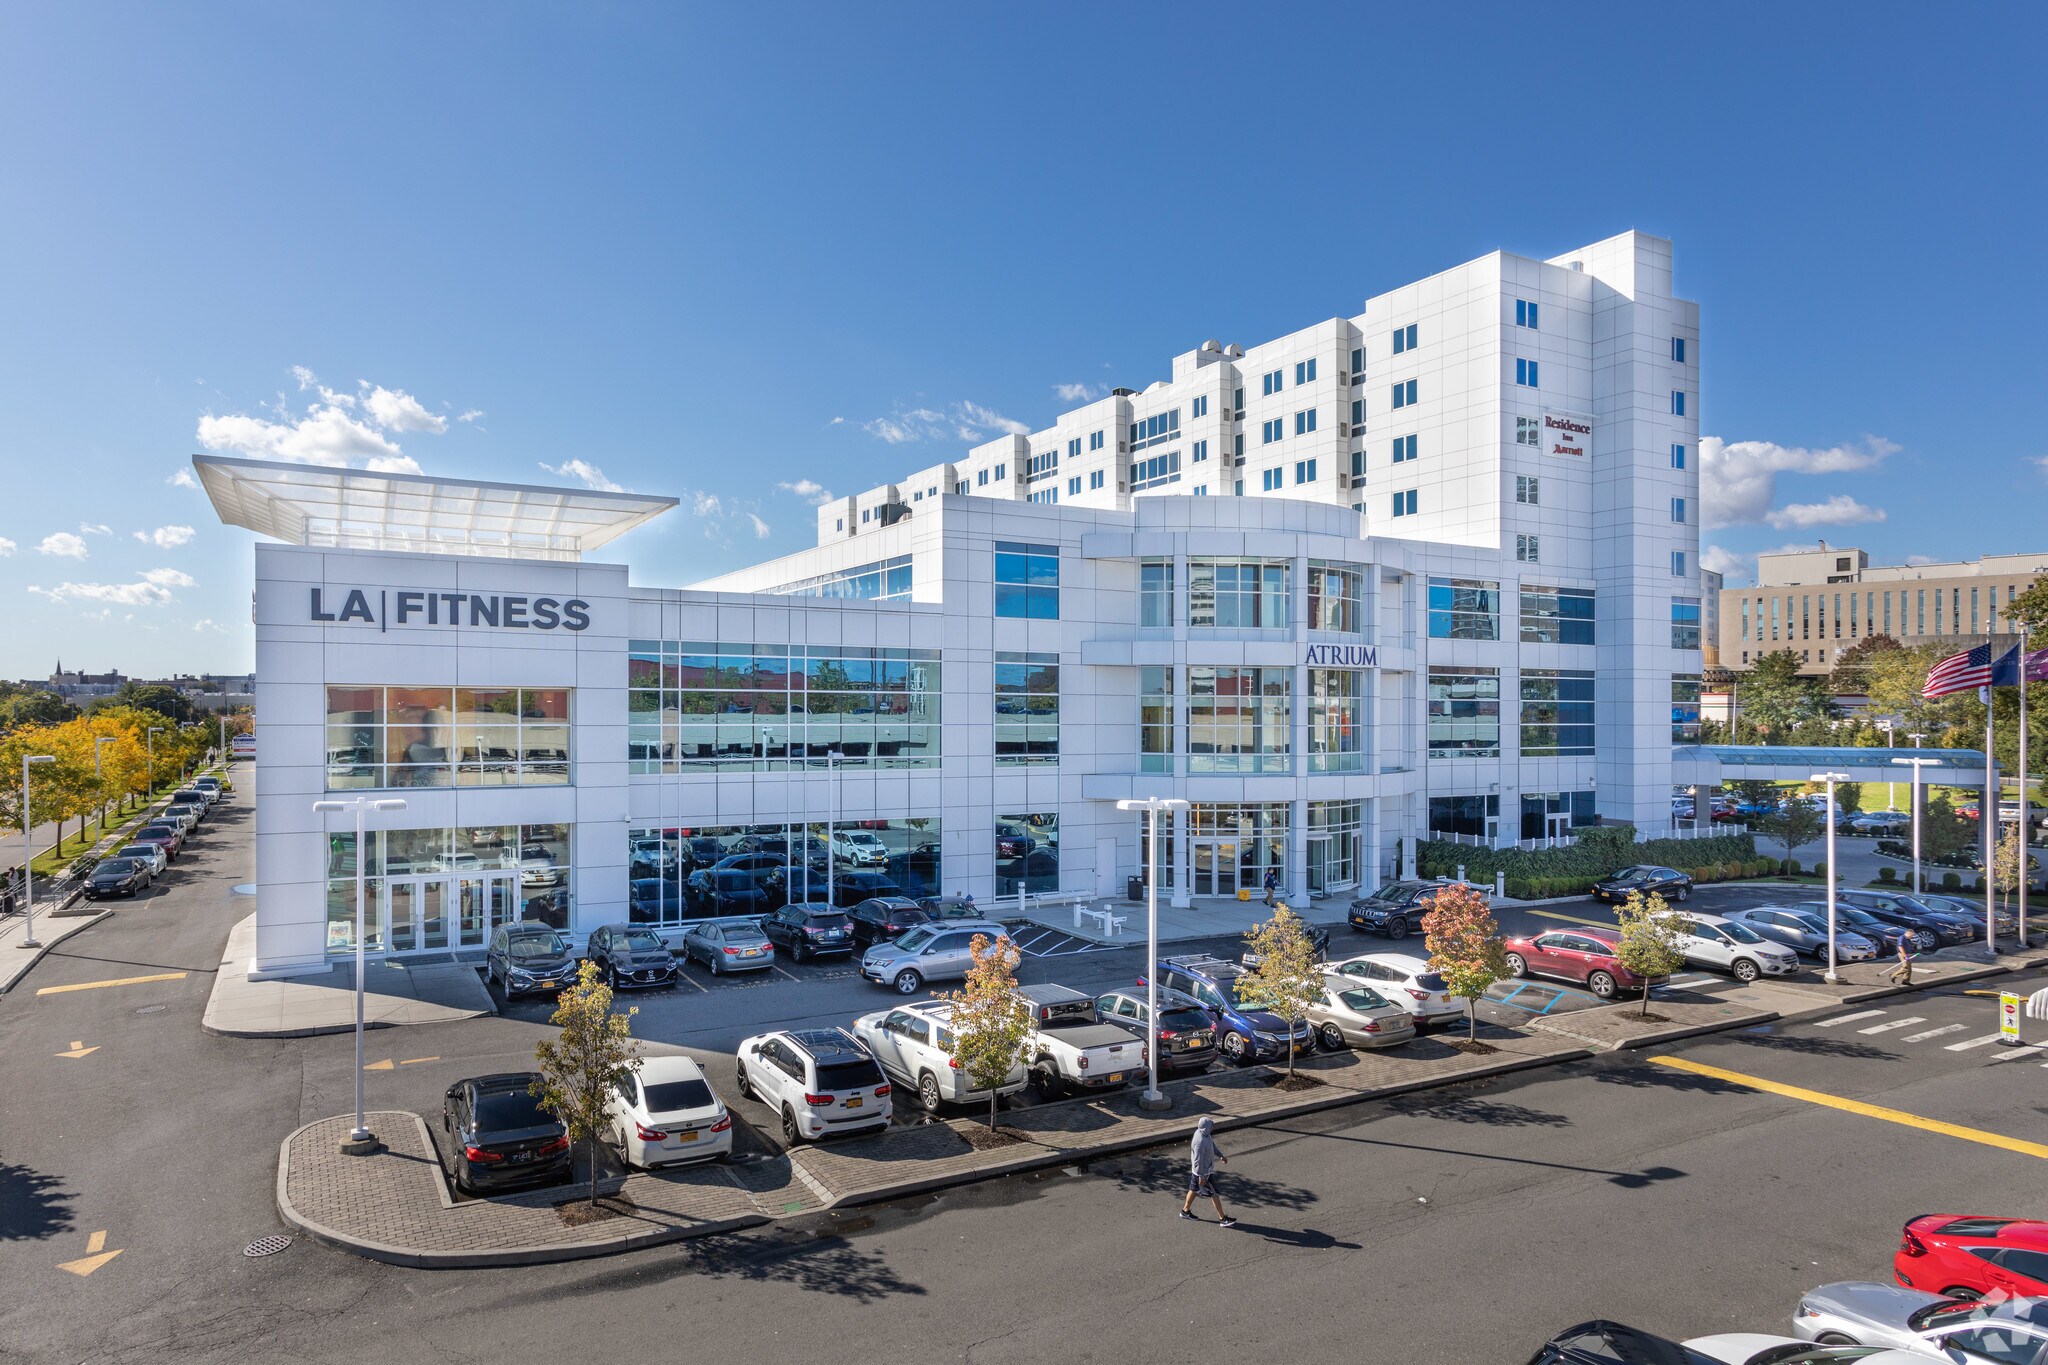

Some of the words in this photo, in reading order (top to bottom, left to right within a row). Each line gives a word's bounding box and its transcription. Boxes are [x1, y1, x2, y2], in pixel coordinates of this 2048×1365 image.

[1545, 416, 1590, 434] Residence
[1562, 433, 1573, 441] Inn
[1553, 444, 1583, 456] Marriott
[1305, 644, 1377, 666] ATRIUM
